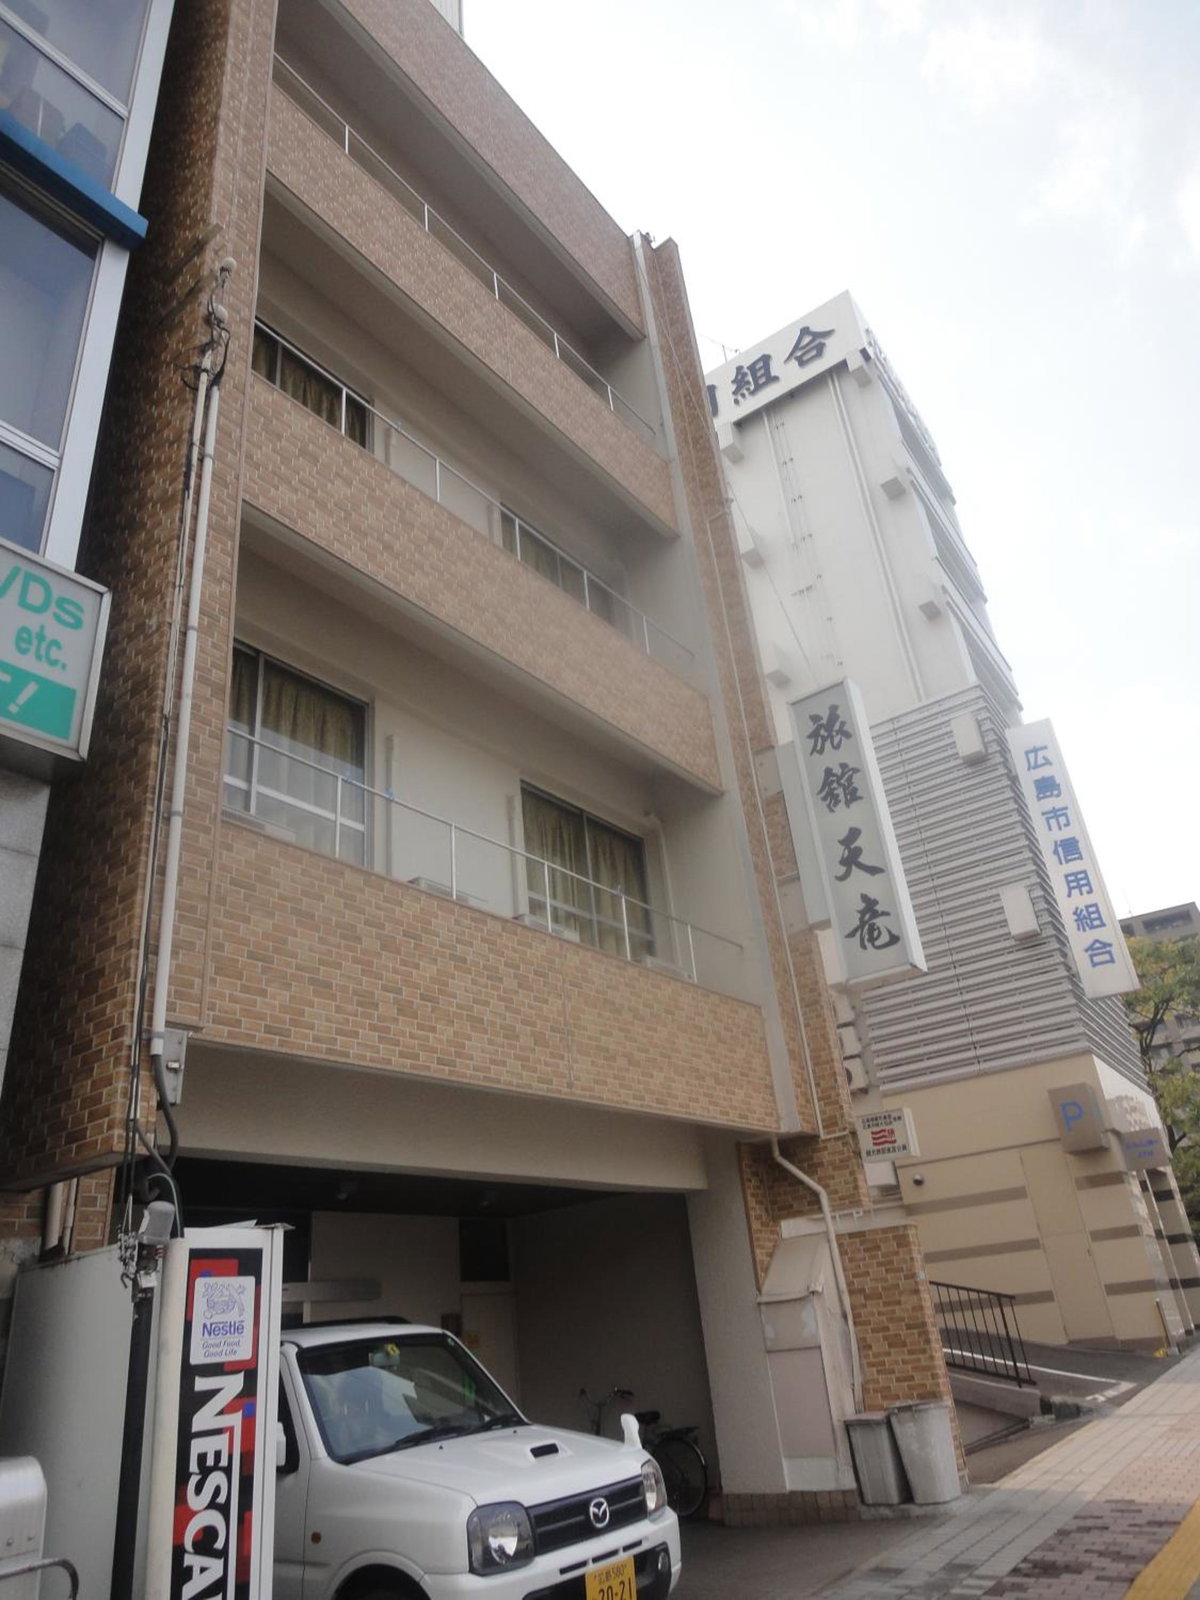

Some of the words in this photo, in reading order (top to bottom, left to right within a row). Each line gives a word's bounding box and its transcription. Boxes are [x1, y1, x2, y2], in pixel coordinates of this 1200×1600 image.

[706, 326, 835, 418] 組合
[14, 623, 68, 670] etc.
[1024, 745, 1116, 968] 広島市信用組合
[1060, 1101, 1085, 1136] P
[203, 1349, 223, 1358] Good
[224, 1348, 238, 1357] Life
[181, 1370, 245, 1600] NESCA
